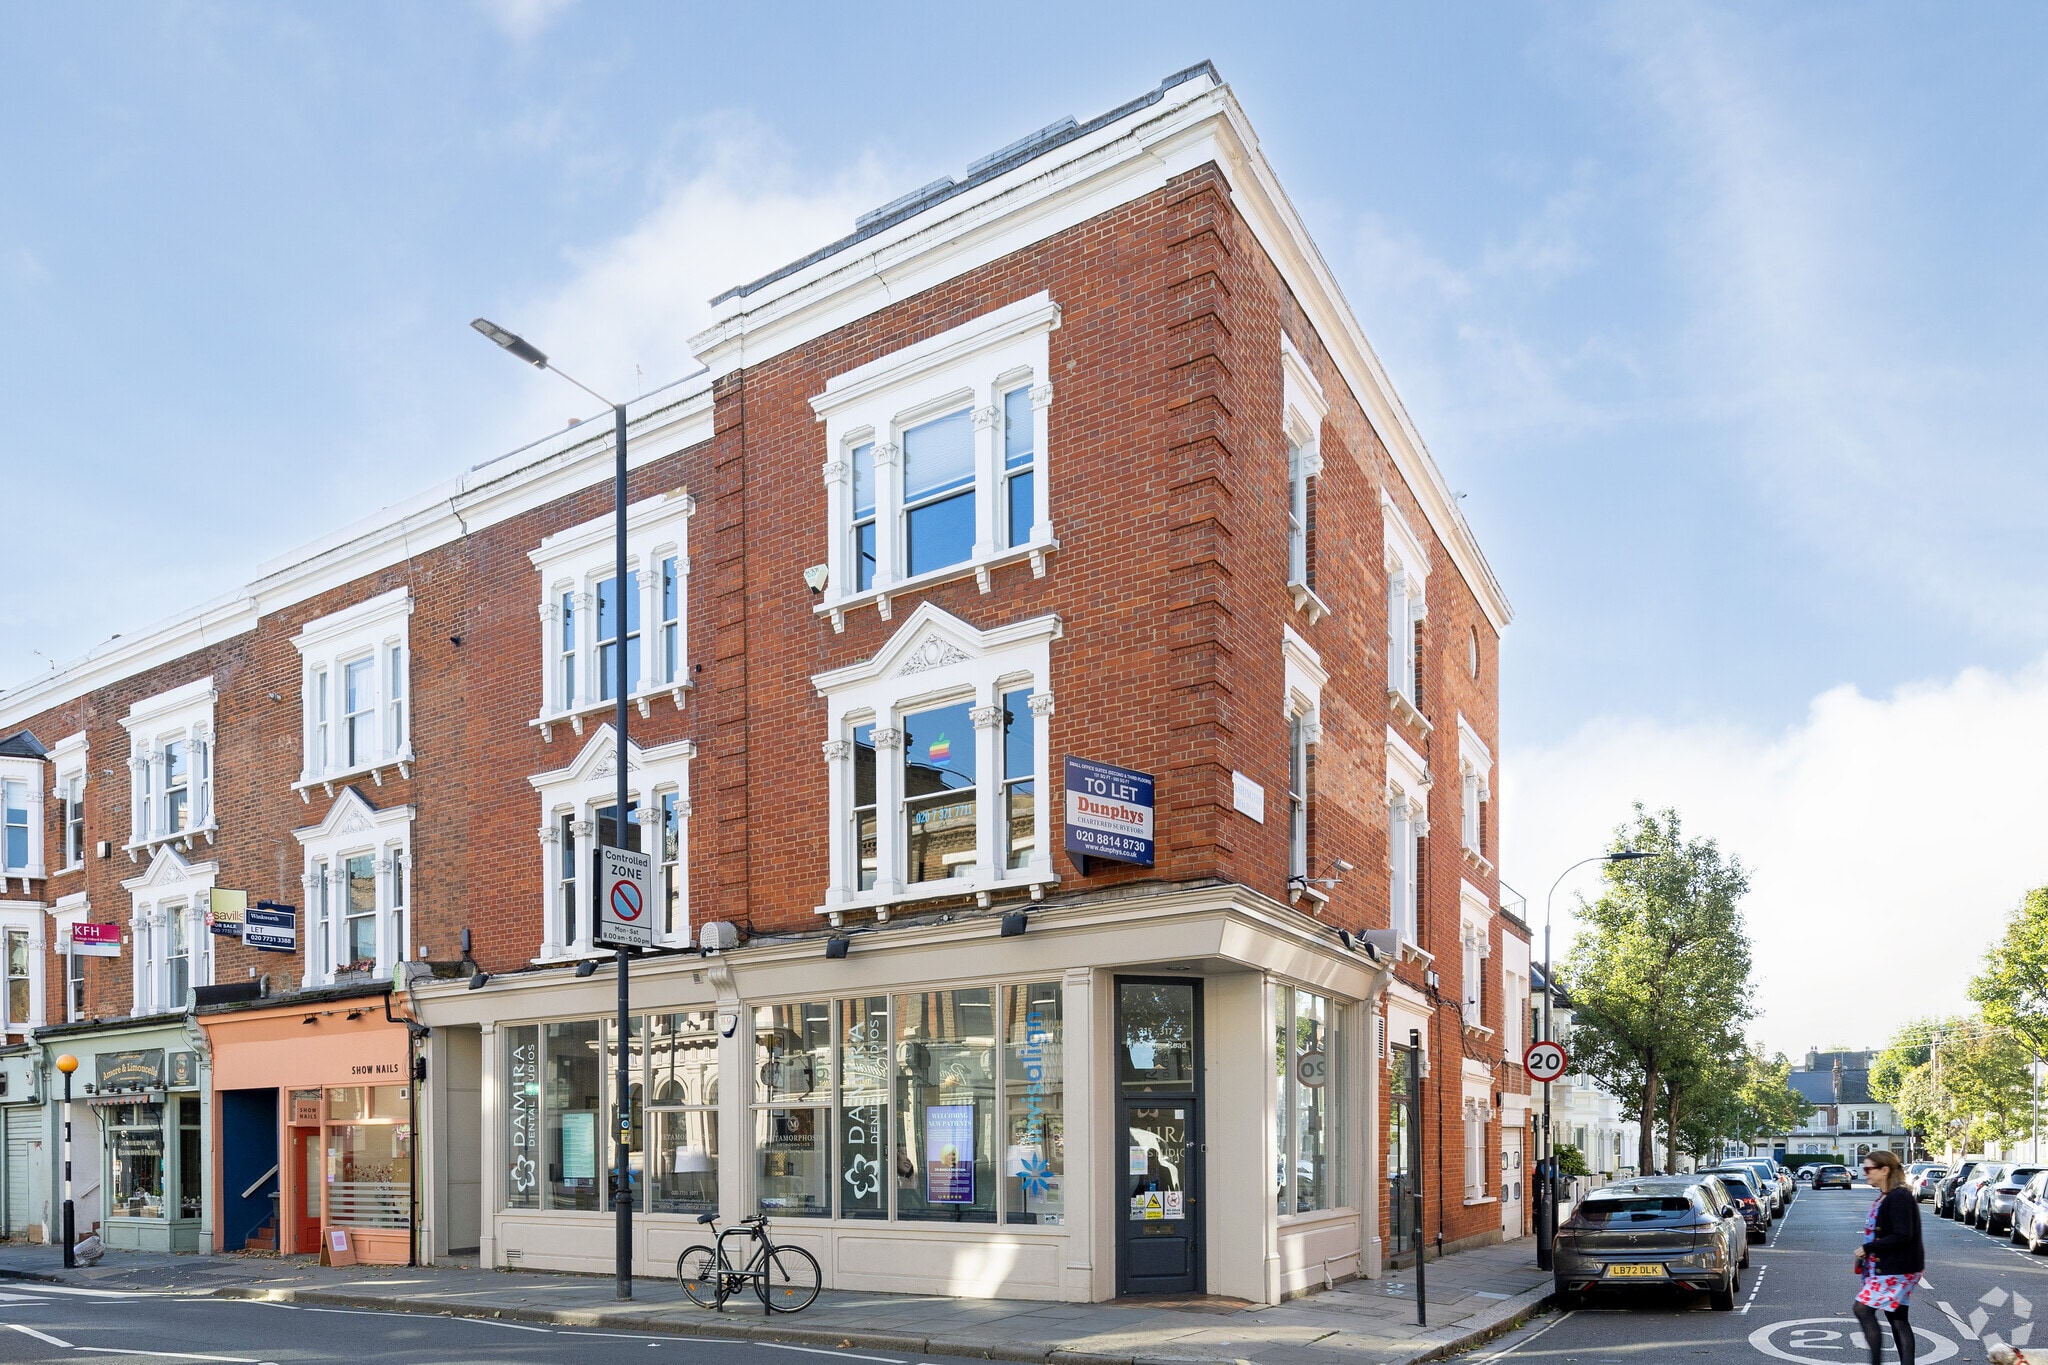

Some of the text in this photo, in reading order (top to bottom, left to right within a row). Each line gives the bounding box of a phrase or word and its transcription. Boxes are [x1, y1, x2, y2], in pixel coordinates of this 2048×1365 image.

[1085, 777, 1138, 801] TO LET
[916, 804, 972, 823] 020 7 371 7711
[1078, 796, 1143, 824] Dunphys
[1078, 816, 1143, 834] CHARTERED SURVEYORS
[1076, 829, 1145, 852] 020 8814 8730
[605, 850, 648, 867] Controlled
[1085, 843, 1137, 858] www.dunphys.co.uk
[611, 864, 642, 880] ZONE
[214, 910, 243, 921] savills
[75, 925, 100, 937] KFH
[251, 926, 264, 934] LET
[1160, 1028, 1173, 1036] 317
[352, 1064, 398, 1074] SHOW NAILS
[1530, 1052, 1560, 1070] 20
[103, 1062, 158, 1081] Amore & Limoncello
[1021, 1012, 1047, 1143] invisalign
[870, 1019, 879, 1144] DENT UDIOS
[513, 1044, 526, 1147] DAMIRA
[528, 1101, 536, 1147] DENTAL
[1614, 1266, 1658, 1274] LB72 DLK
